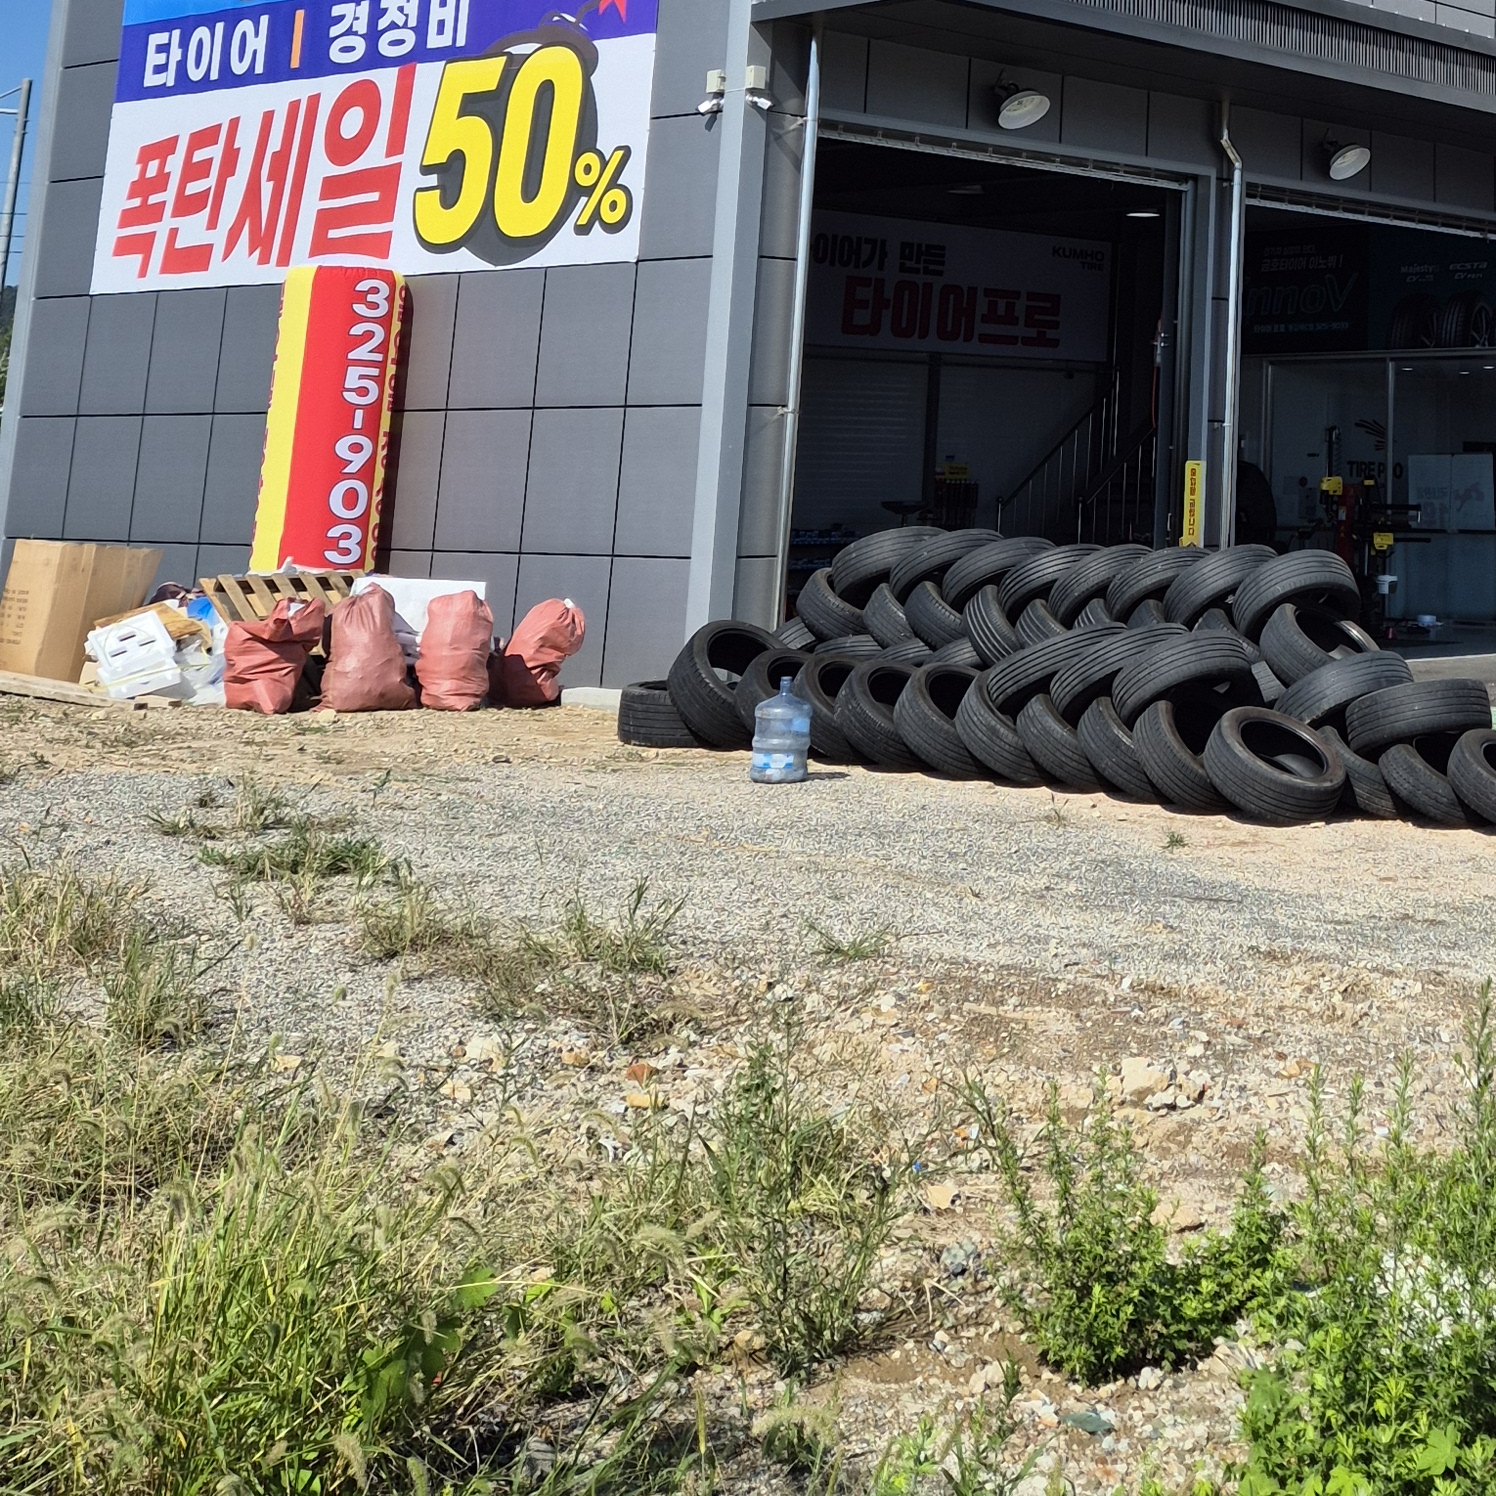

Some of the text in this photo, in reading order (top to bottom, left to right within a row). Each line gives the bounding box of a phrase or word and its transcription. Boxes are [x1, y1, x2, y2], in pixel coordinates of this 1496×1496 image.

[143, 14, 270, 88] 타이어
[112, 44, 634, 279] 폭탄세일 50%
[811, 232, 946, 277] 이어가 만든
[1052, 246, 1105, 262] KUMHO
[1080, 261, 1105, 272] TIRE
[841, 275, 1062, 348] 타이어프로
[322, 278, 391, 570] 325-903
